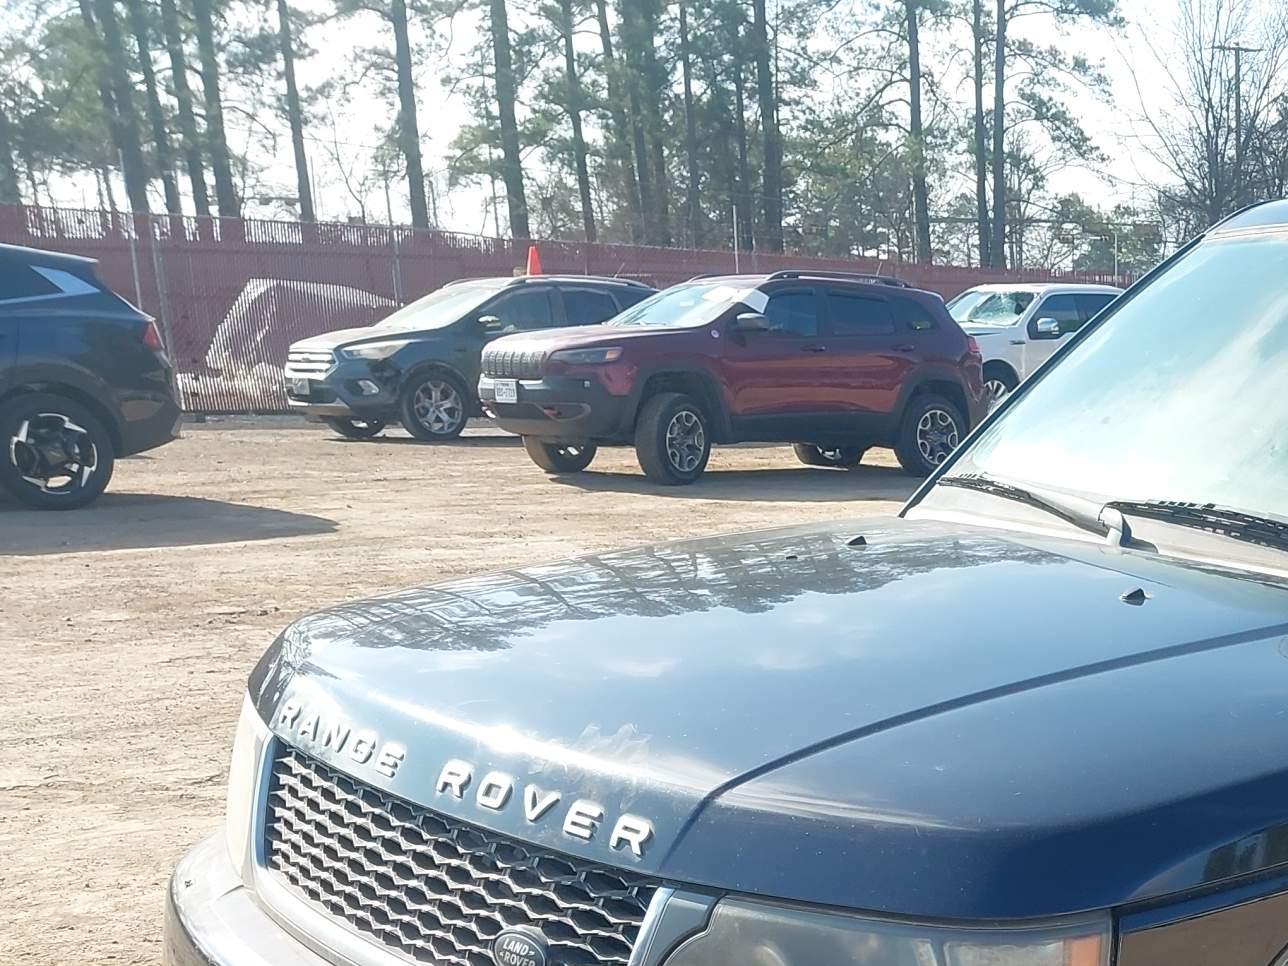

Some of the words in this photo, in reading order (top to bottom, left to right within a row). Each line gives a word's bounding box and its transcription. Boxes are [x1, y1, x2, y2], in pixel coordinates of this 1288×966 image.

[279, 699, 408, 779] RANGE
[436, 757, 657, 858] ROVER
[502, 937, 530, 956] LAND
